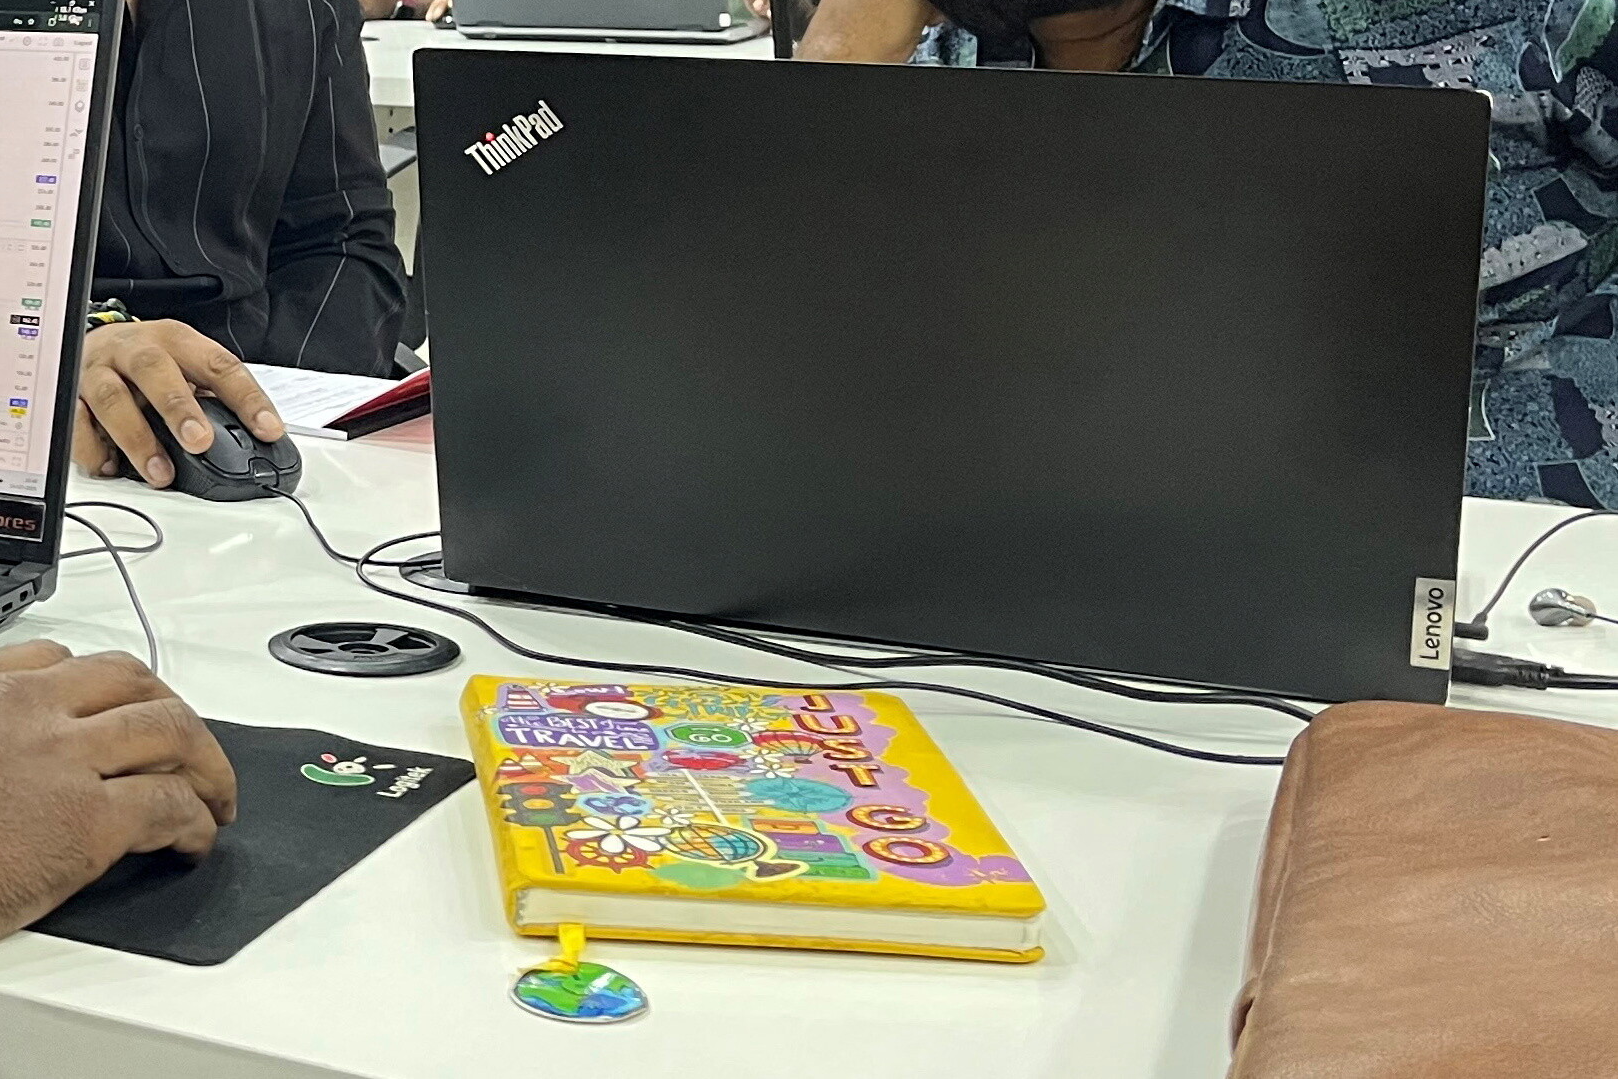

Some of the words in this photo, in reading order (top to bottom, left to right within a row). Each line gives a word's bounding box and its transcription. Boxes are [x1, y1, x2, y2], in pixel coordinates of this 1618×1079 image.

[464, 100, 564, 175] ThinkPad
[1419, 587, 1445, 660] Lenovo
[504, 727, 649, 750] TRAVEL
[791, 693, 882, 788] JUST
